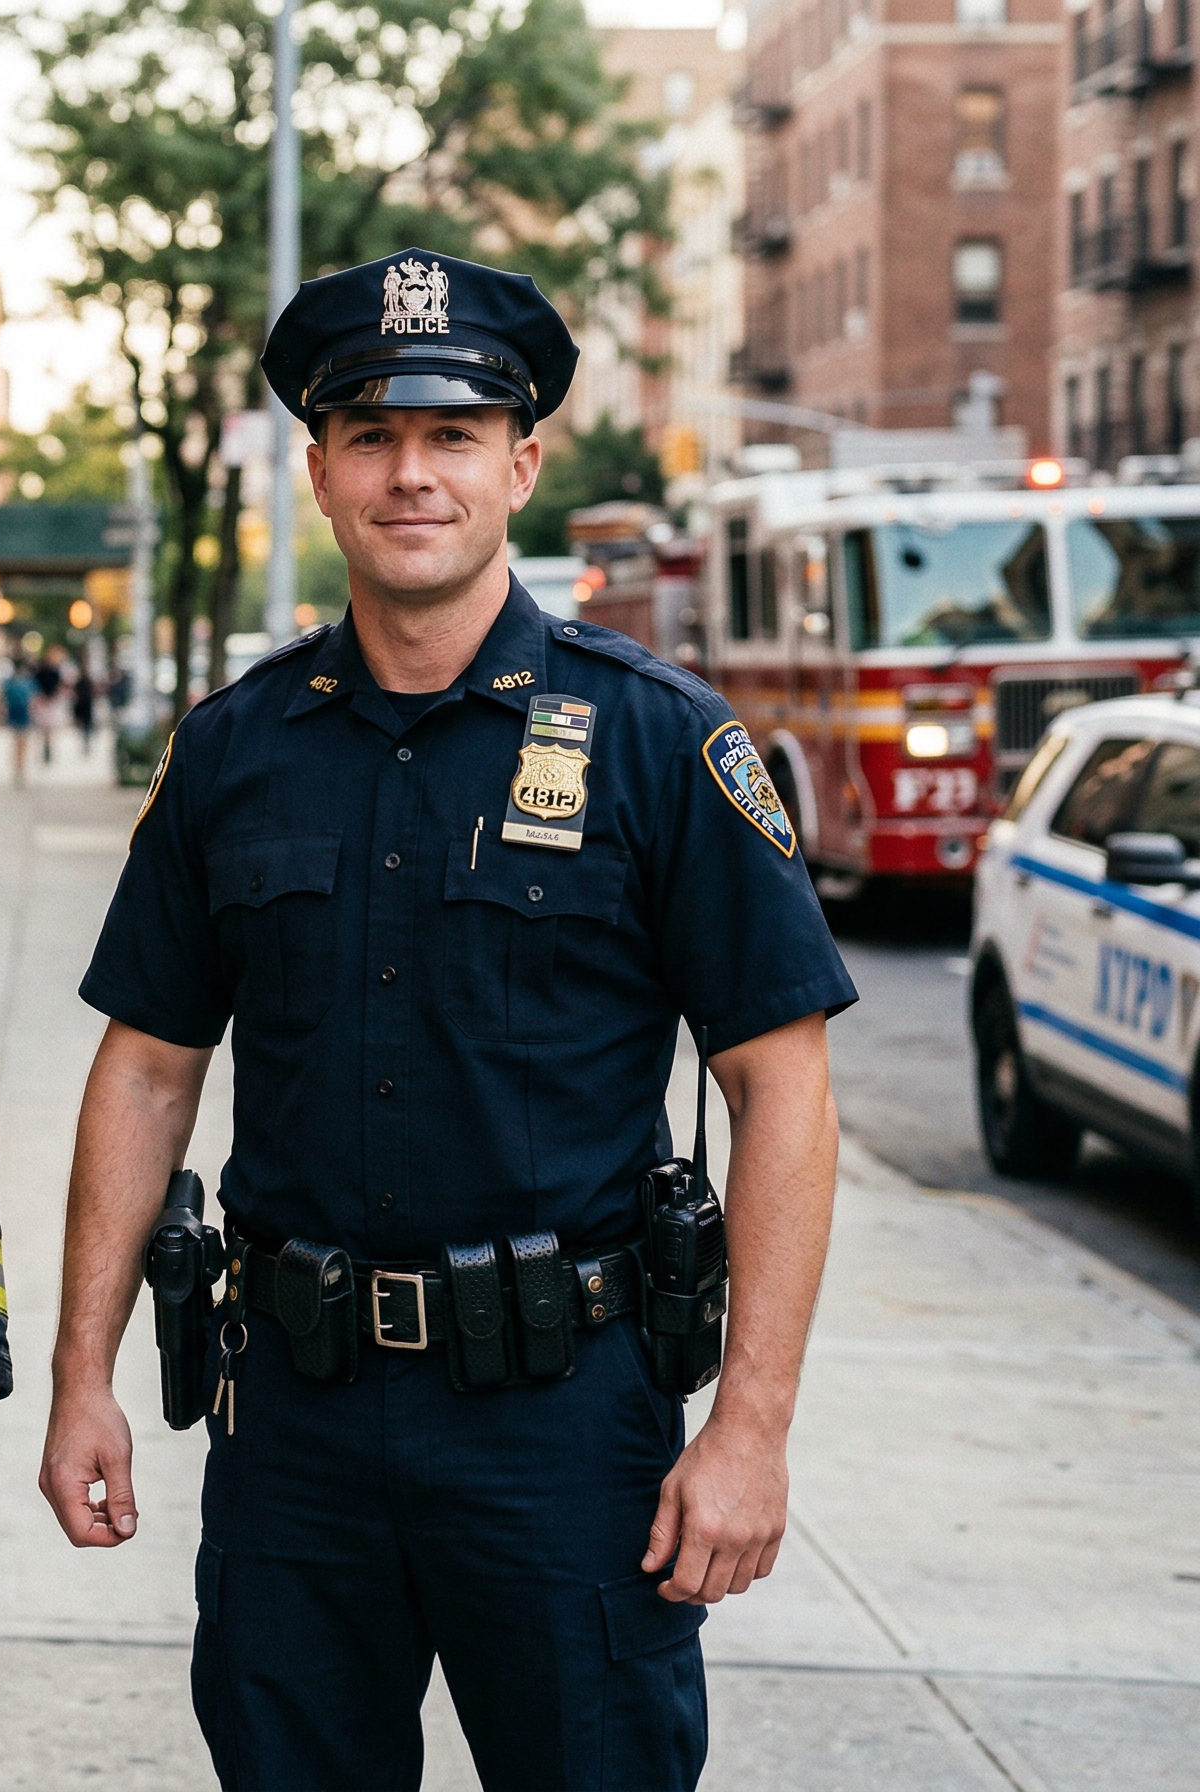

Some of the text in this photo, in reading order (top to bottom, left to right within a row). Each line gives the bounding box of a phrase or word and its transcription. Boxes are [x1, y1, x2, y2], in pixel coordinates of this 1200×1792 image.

[380, 317, 450, 335] POLICE
[309, 675, 338, 693] 4812
[492, 670, 536, 691] 4812
[521, 786, 575, 811] 4812
